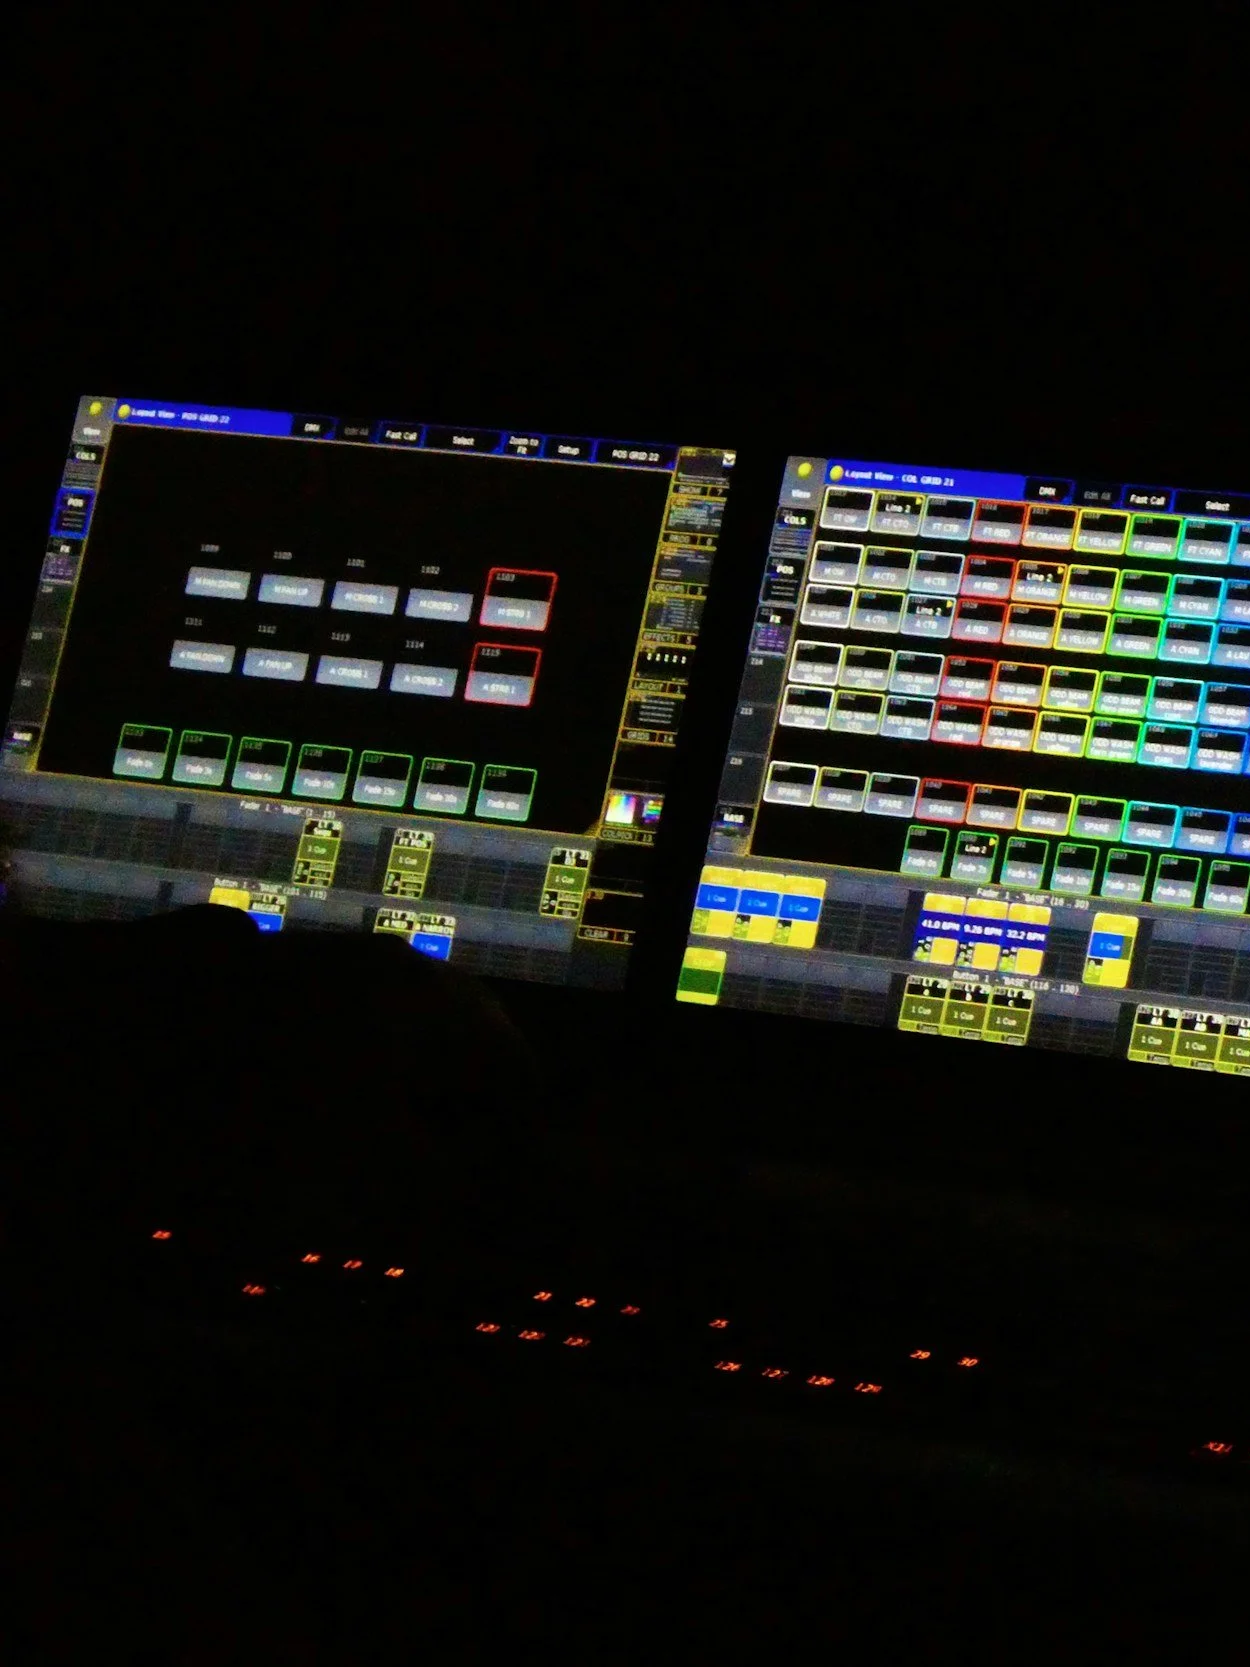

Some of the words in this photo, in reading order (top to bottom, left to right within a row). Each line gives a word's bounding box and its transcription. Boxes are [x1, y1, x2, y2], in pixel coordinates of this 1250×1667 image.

[387, 430, 402, 439] Fast
[404, 432, 417, 441] Call
[453, 436, 474, 445] Select
[509, 437, 528, 445] Zoom
[530, 438, 539, 446] to
[612, 449, 628, 459] POS
[629, 451, 648, 461] GRID
[650, 453, 660, 461] 22
[845, 470, 872, 479] Layout
[875, 472, 893, 481] View
[902, 474, 918, 483] COL
[920, 477, 941, 485] GRID
[943, 478, 954, 487] 21
[1130, 495, 1149, 504] Fast
[1150, 497, 1166, 506] Call
[1206, 501, 1230, 511] Select
[784, 516, 806, 525] COLS
[1200, 547, 1221, 557] CYAN
[777, 566, 794, 574] POS
[1124, 641, 1150, 651] GREEN
[929, 805, 953, 814] SPARE
[724, 813, 744, 823] BASE
[1032, 816, 1056, 827] SPARE
[922, 919, 940, 929] 41.0
[942, 921, 960, 931] BPM
[984, 926, 1002, 937] BPM
[1007, 930, 1025, 939] 32.2
[1026, 931, 1045, 942] BPM
[910, 1349, 931, 1360] 29
[958, 1356, 979, 1368] 30
